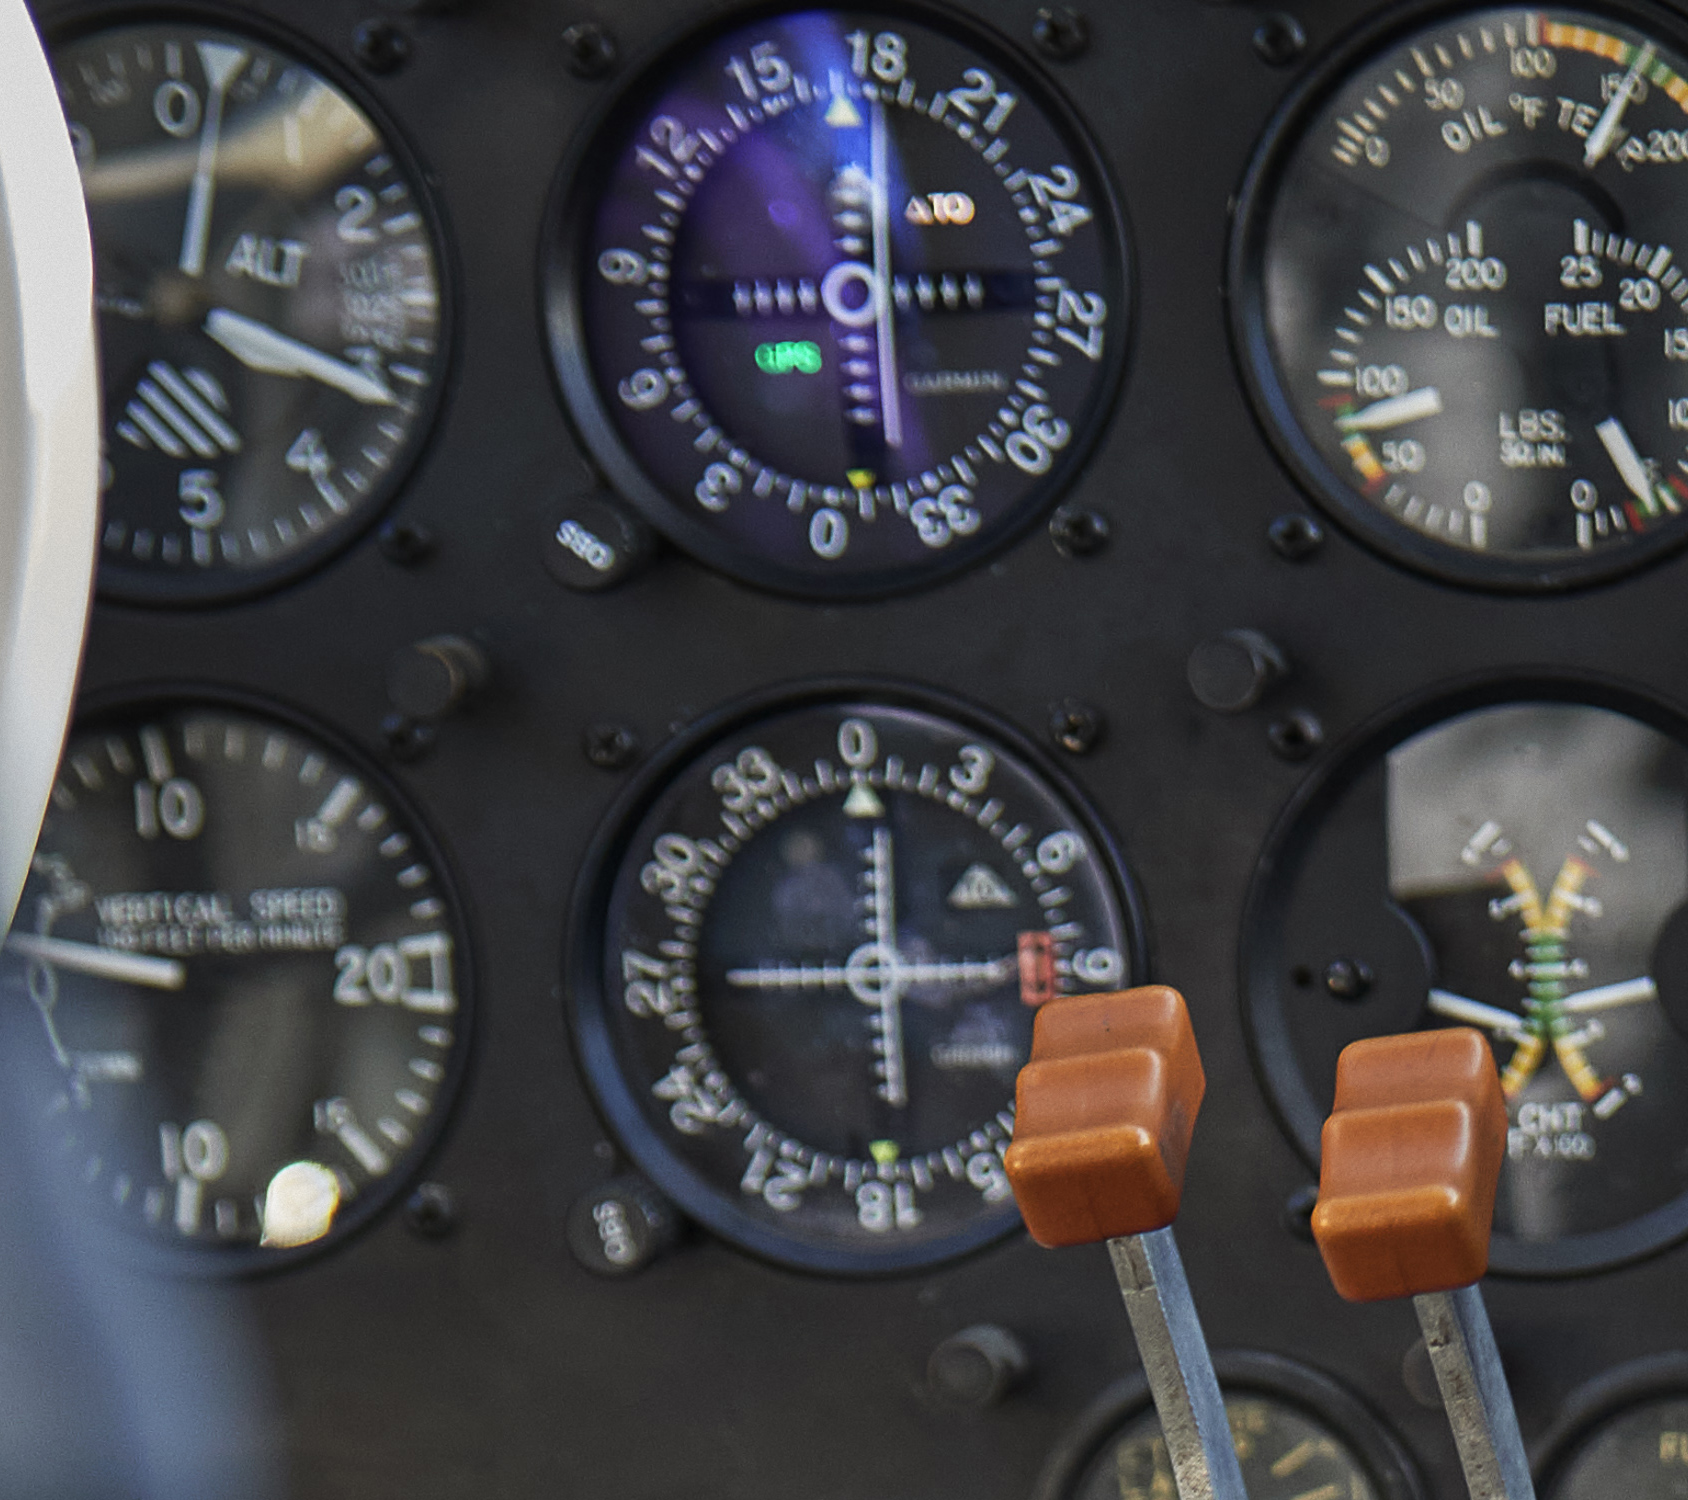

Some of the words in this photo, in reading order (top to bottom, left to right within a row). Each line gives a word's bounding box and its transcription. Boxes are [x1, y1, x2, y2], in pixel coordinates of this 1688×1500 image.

[726, 41, 791, 100] 15
[846, 30, 908, 81] 18
[946, 68, 1016, 134] 21
[333, 185, 378, 242] 2
[1028, 165, 1093, 236] 24
[1055, 291, 1107, 360] 27
[334, 943, 402, 1005] 20
